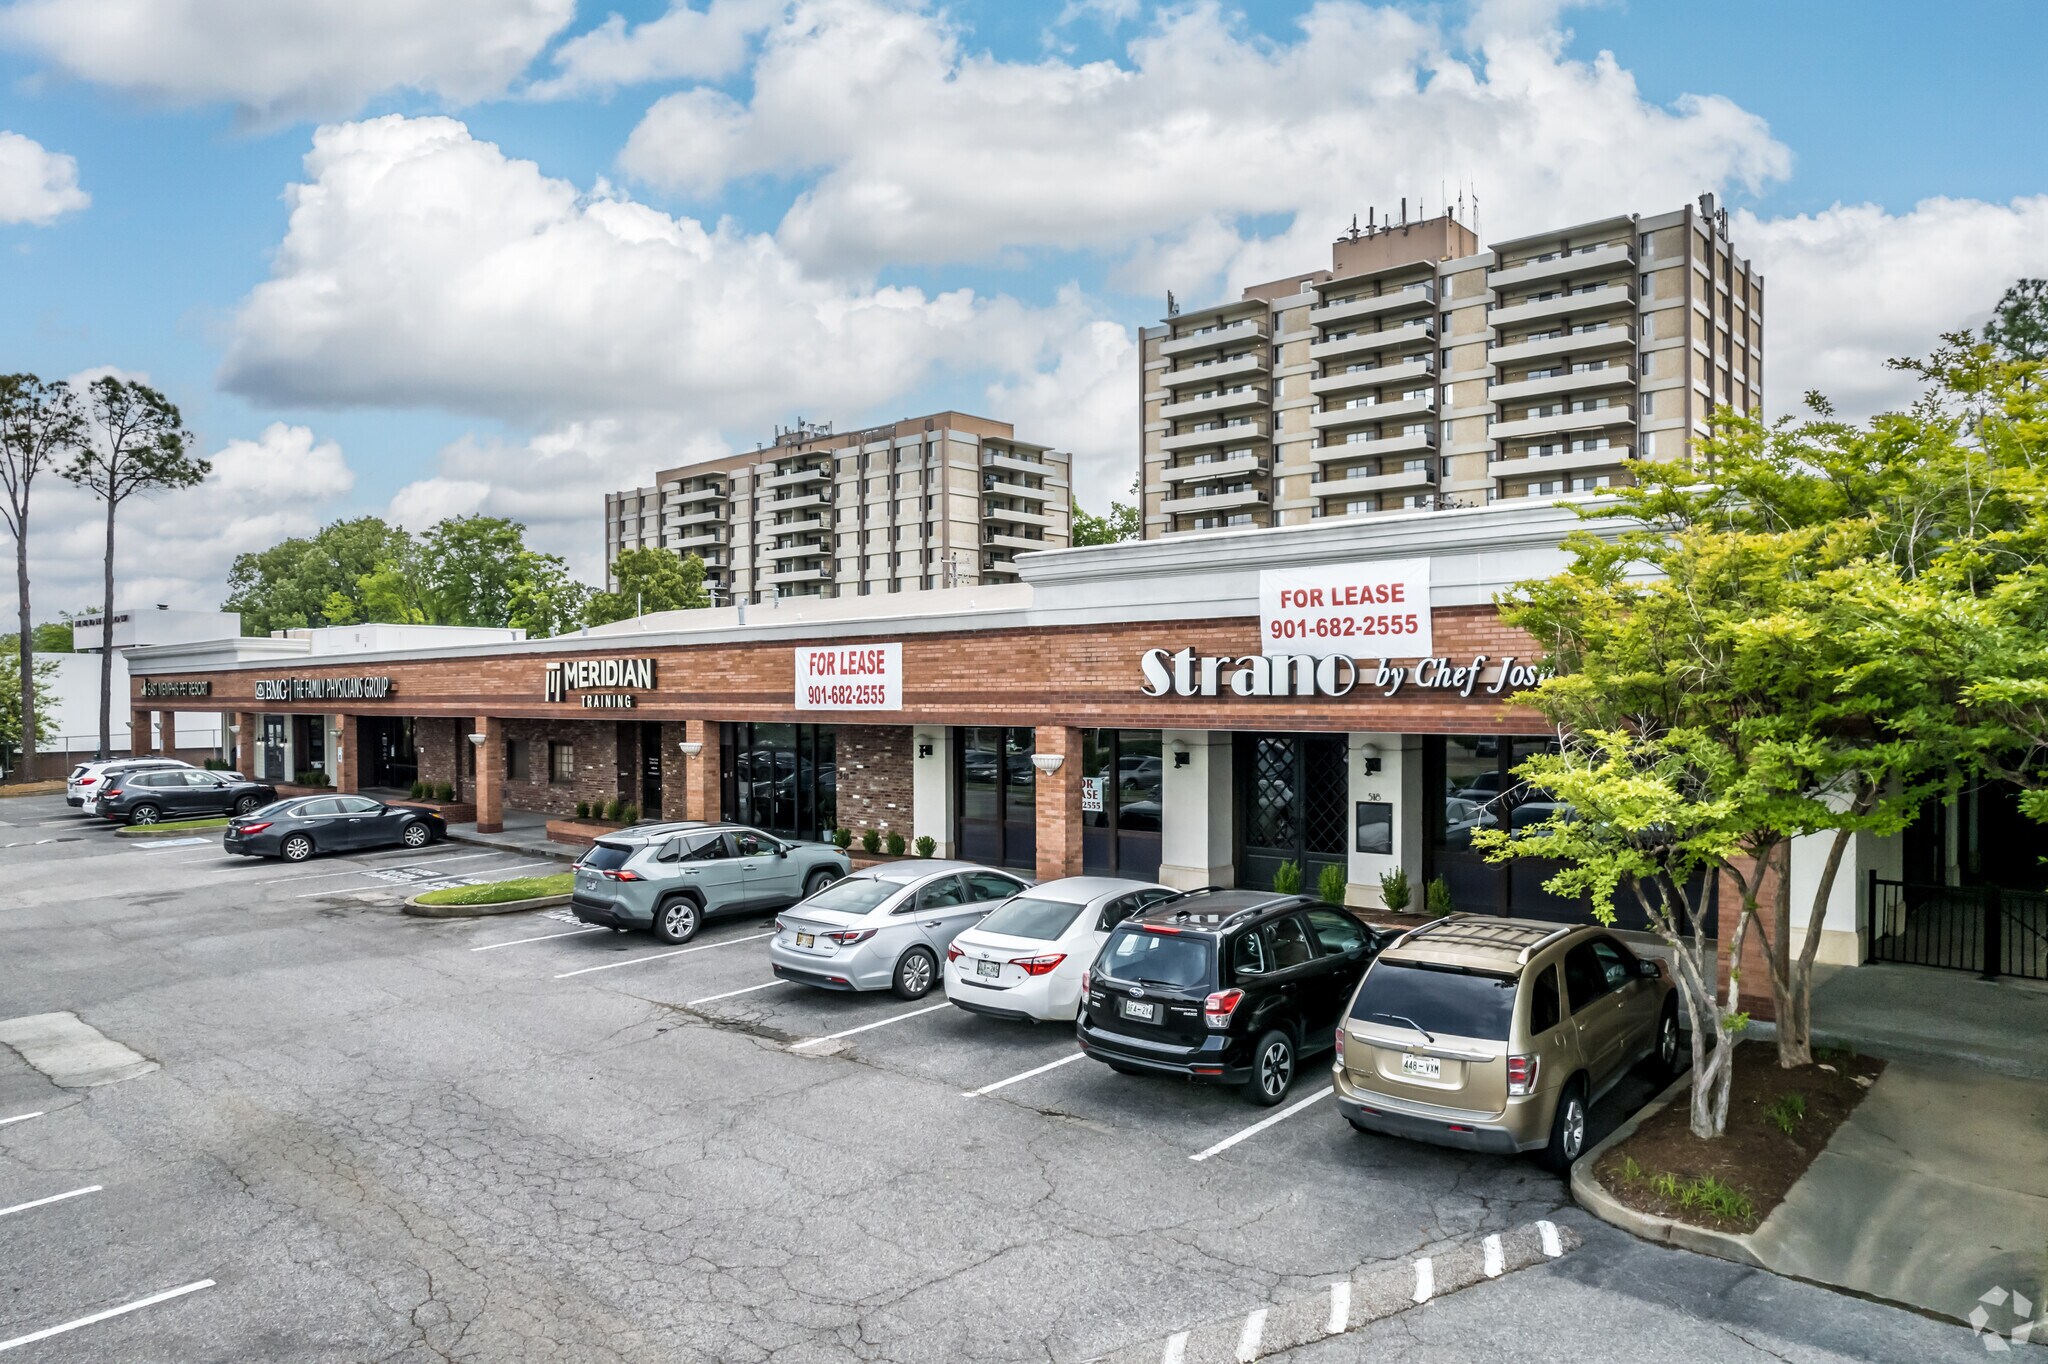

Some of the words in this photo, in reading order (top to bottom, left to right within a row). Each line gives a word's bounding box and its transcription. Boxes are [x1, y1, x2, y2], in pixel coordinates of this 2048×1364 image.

[1281, 588, 1324, 609] FOR
[1331, 583, 1405, 606] LEASE
[1271, 614, 1418, 639] 901-682-2555
[564, 658, 652, 691] MERIDIAN
[809, 652, 836, 676] FOR
[840, 650, 885, 675] LEASE
[1140, 646, 1358, 697] Strano
[1375, 658, 1404, 697] by
[1415, 655, 1486, 698] Chef
[265, 679, 287, 700] BMG
[293, 680, 304, 699] THE
[305, 679, 325, 699] FAMILY
[326, 678, 363, 699] PHYSICIANS
[364, 676, 389, 698] GROUP
[808, 685, 885, 705] 901-682-2555
[581, 695, 632, 708] TRAINING
[1404, 1060, 1439, 1074] 448-VXM
